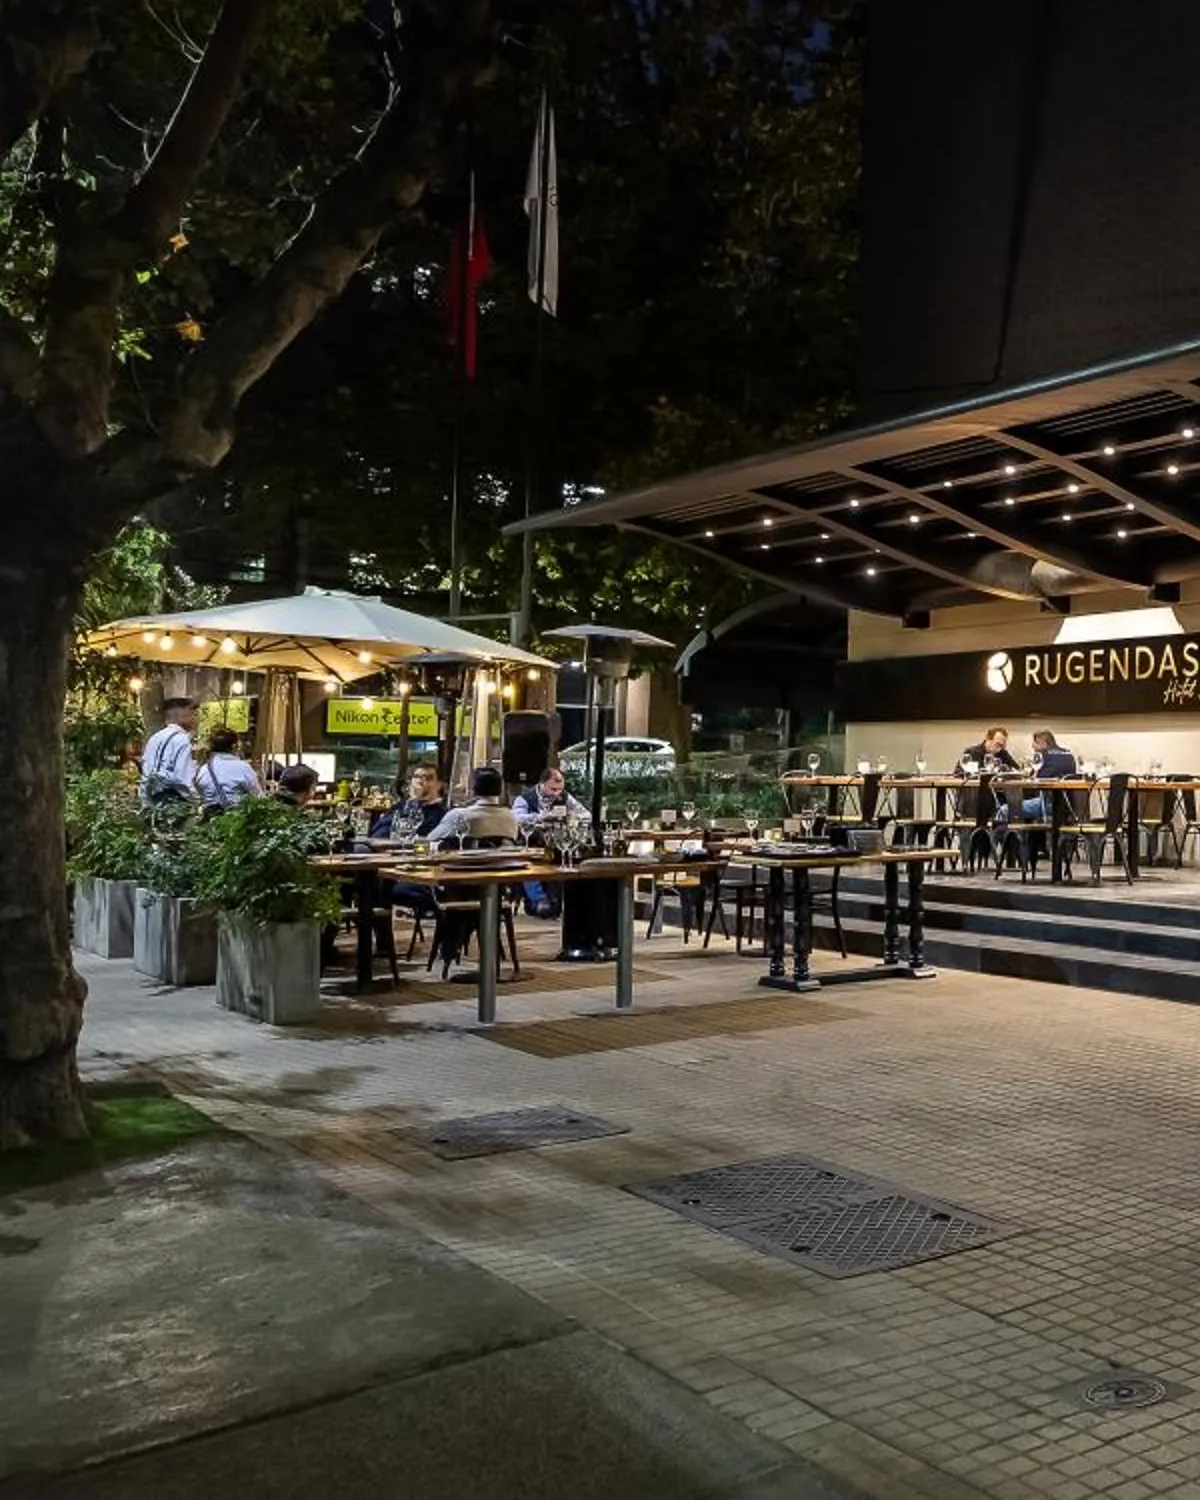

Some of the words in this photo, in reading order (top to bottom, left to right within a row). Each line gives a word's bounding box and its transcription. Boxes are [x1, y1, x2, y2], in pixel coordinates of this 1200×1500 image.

[1024, 643, 1200, 687] RUGENDAS
[1163, 677, 1197, 704] Hotel
[335, 709, 379, 724] Nikon
[383, 710, 433, 726] Ceter
